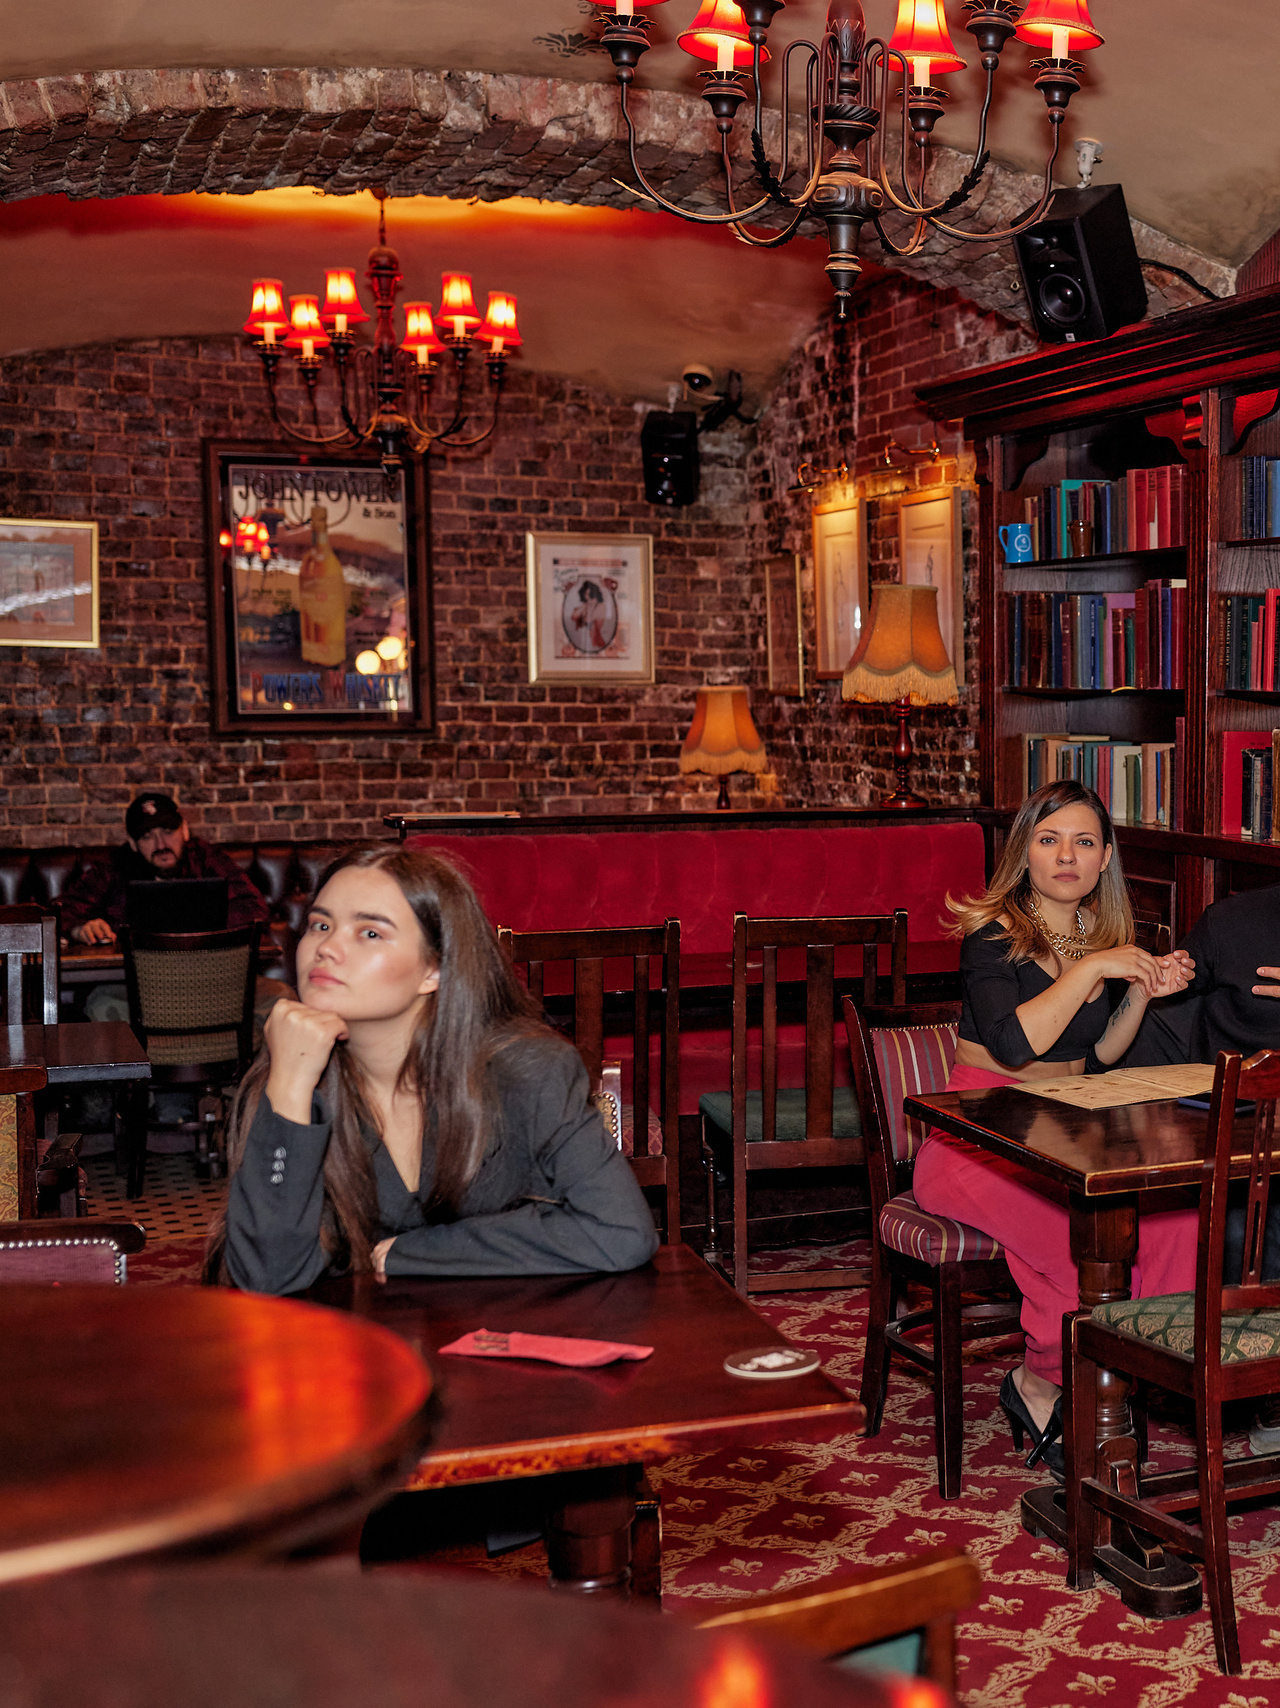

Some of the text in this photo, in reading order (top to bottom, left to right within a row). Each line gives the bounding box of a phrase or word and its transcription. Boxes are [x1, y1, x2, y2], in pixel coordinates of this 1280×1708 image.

[238, 474, 398, 502] JOHN POWER
[252, 671, 323, 702] POWER'S
